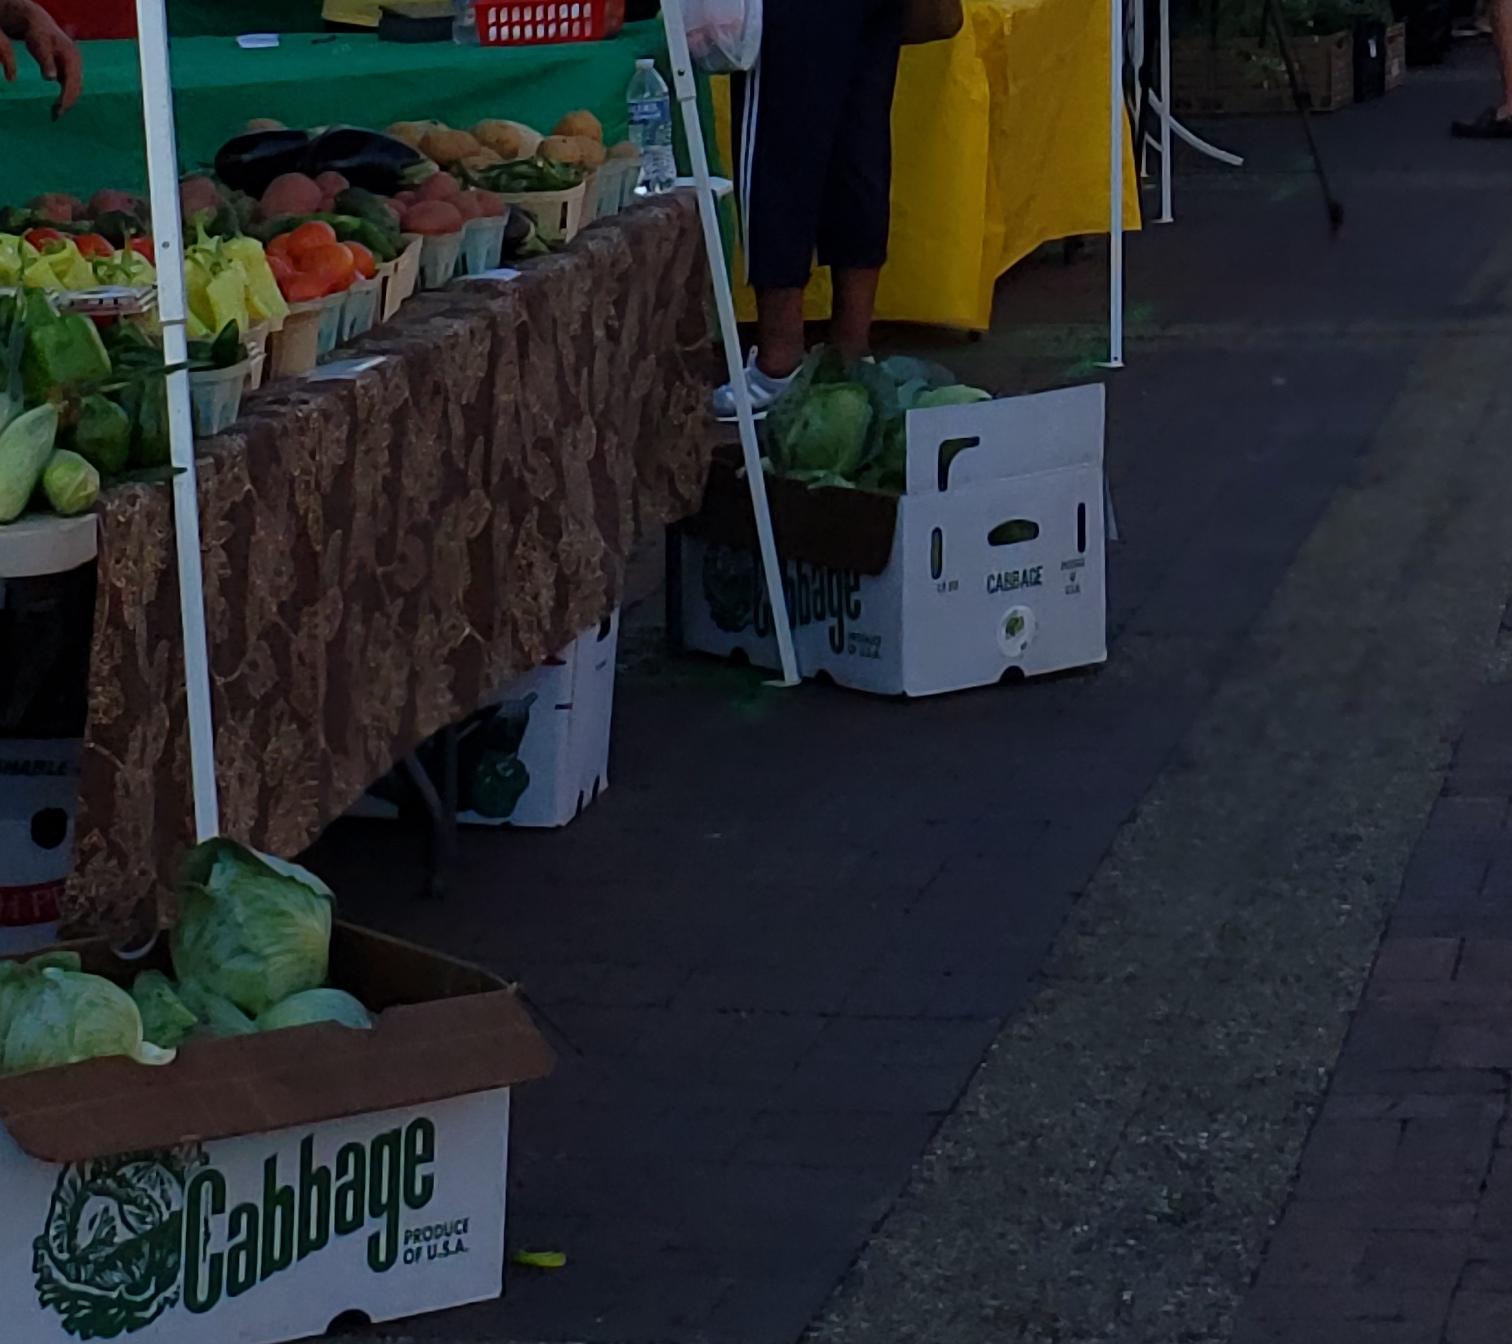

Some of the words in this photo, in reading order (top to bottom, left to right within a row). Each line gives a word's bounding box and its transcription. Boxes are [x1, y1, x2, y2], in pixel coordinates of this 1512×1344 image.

[986, 564, 1043, 594] CABBAGE
[184, 1118, 434, 1313] Cabbage
[403, 1217, 470, 1246] PRODUCE
